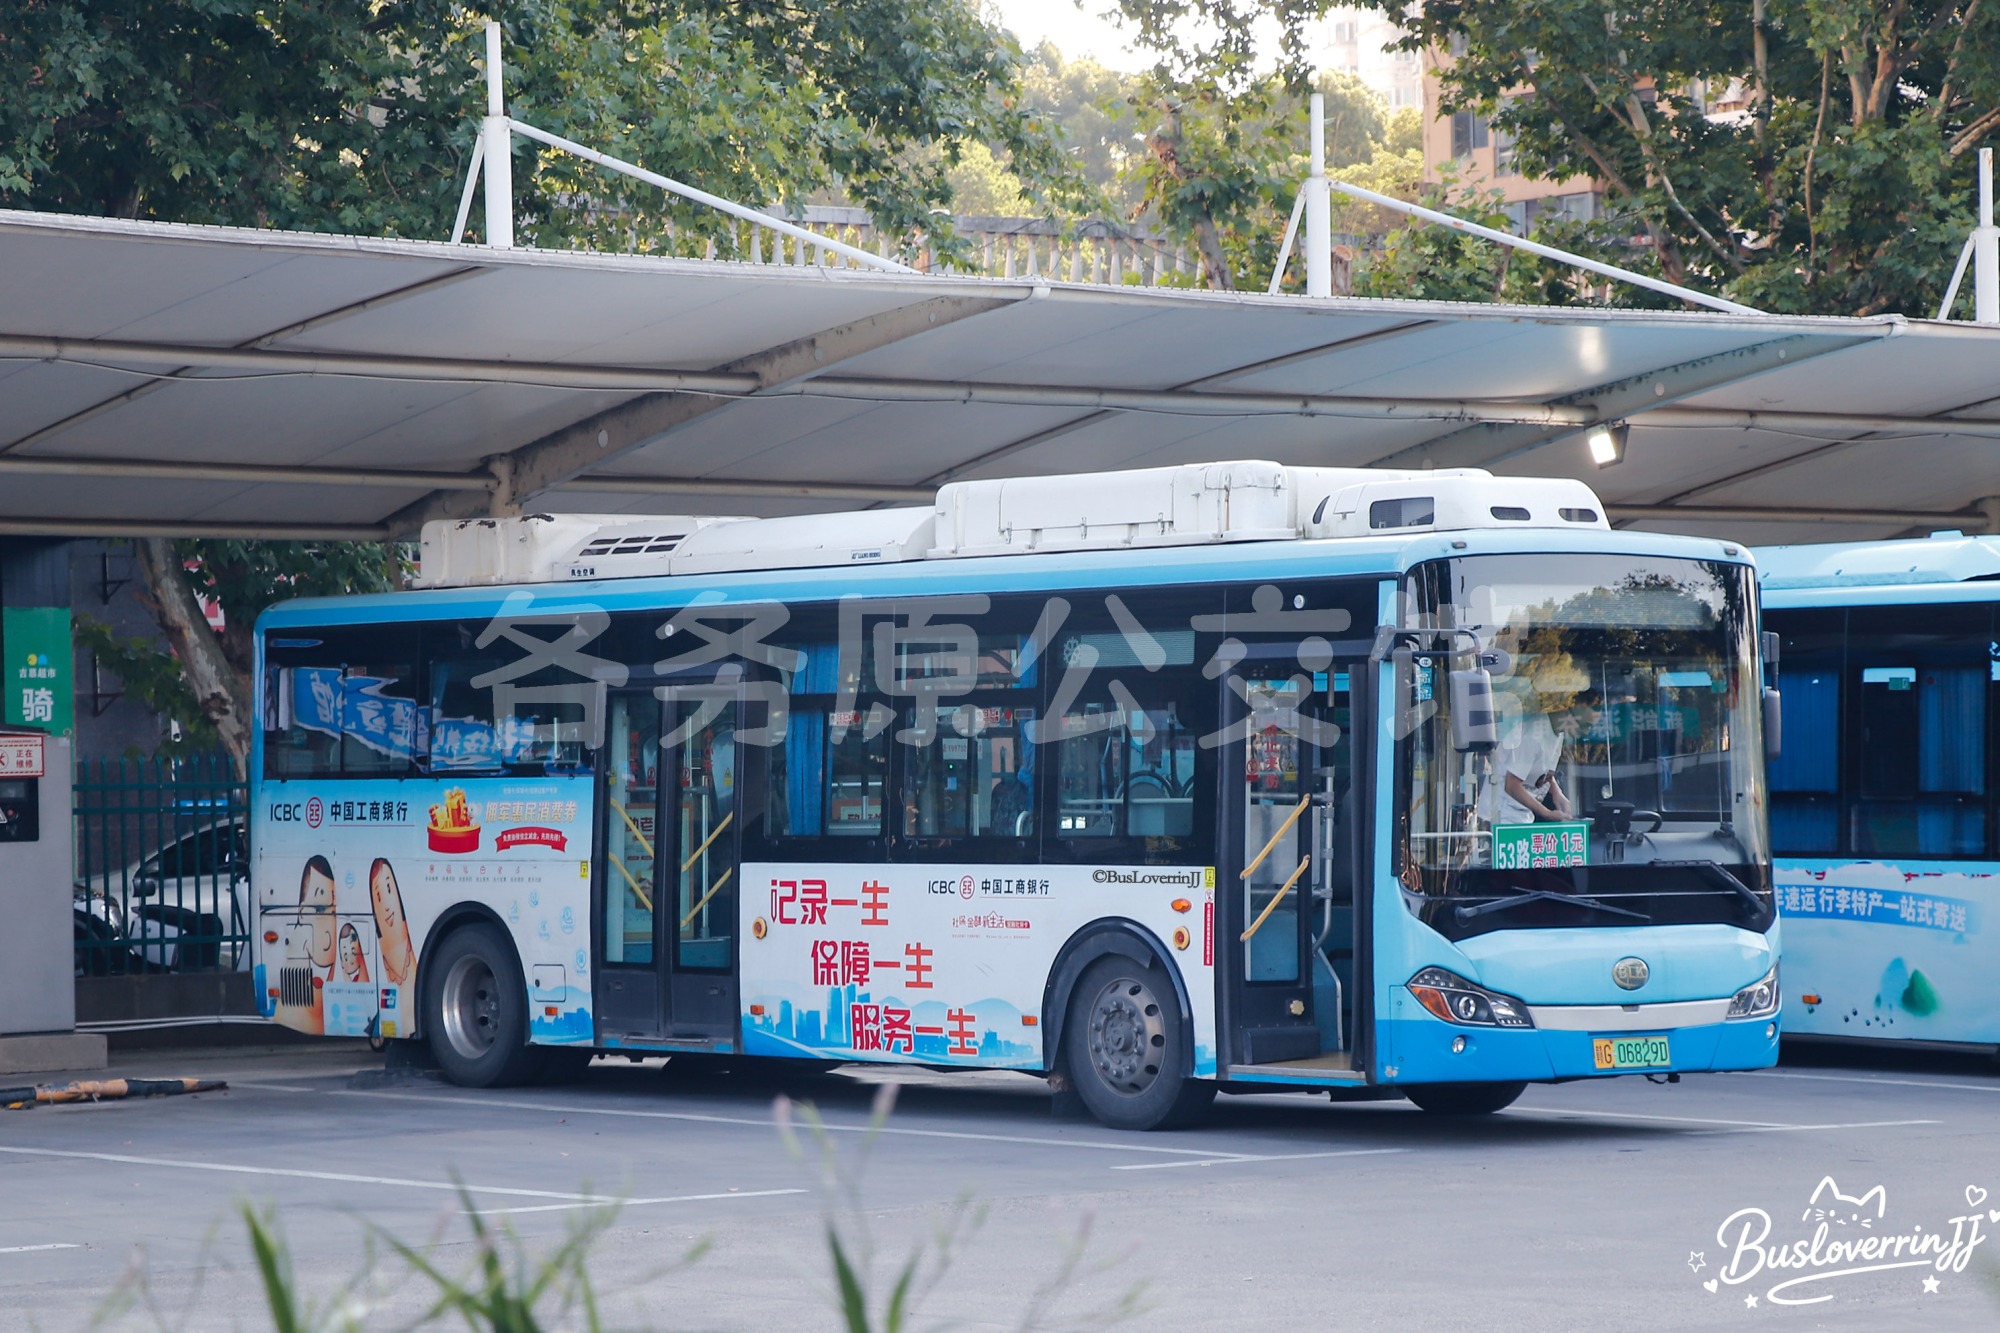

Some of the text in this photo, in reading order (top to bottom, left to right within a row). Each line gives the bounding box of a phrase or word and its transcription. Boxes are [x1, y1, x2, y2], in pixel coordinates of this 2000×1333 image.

[22, 687, 54, 722] 骑
[16, 749, 33, 758] 正在
[270, 801, 408, 822] ICBC 中国工商银行
[1499, 839, 1530, 869] 53路
[770, 879, 889, 926] 记录一生
[928, 878, 1049, 896] ICBC 中国工商银行
[811, 940, 933, 989] 保障一生
[851, 1003, 978, 1056] 服务一生
